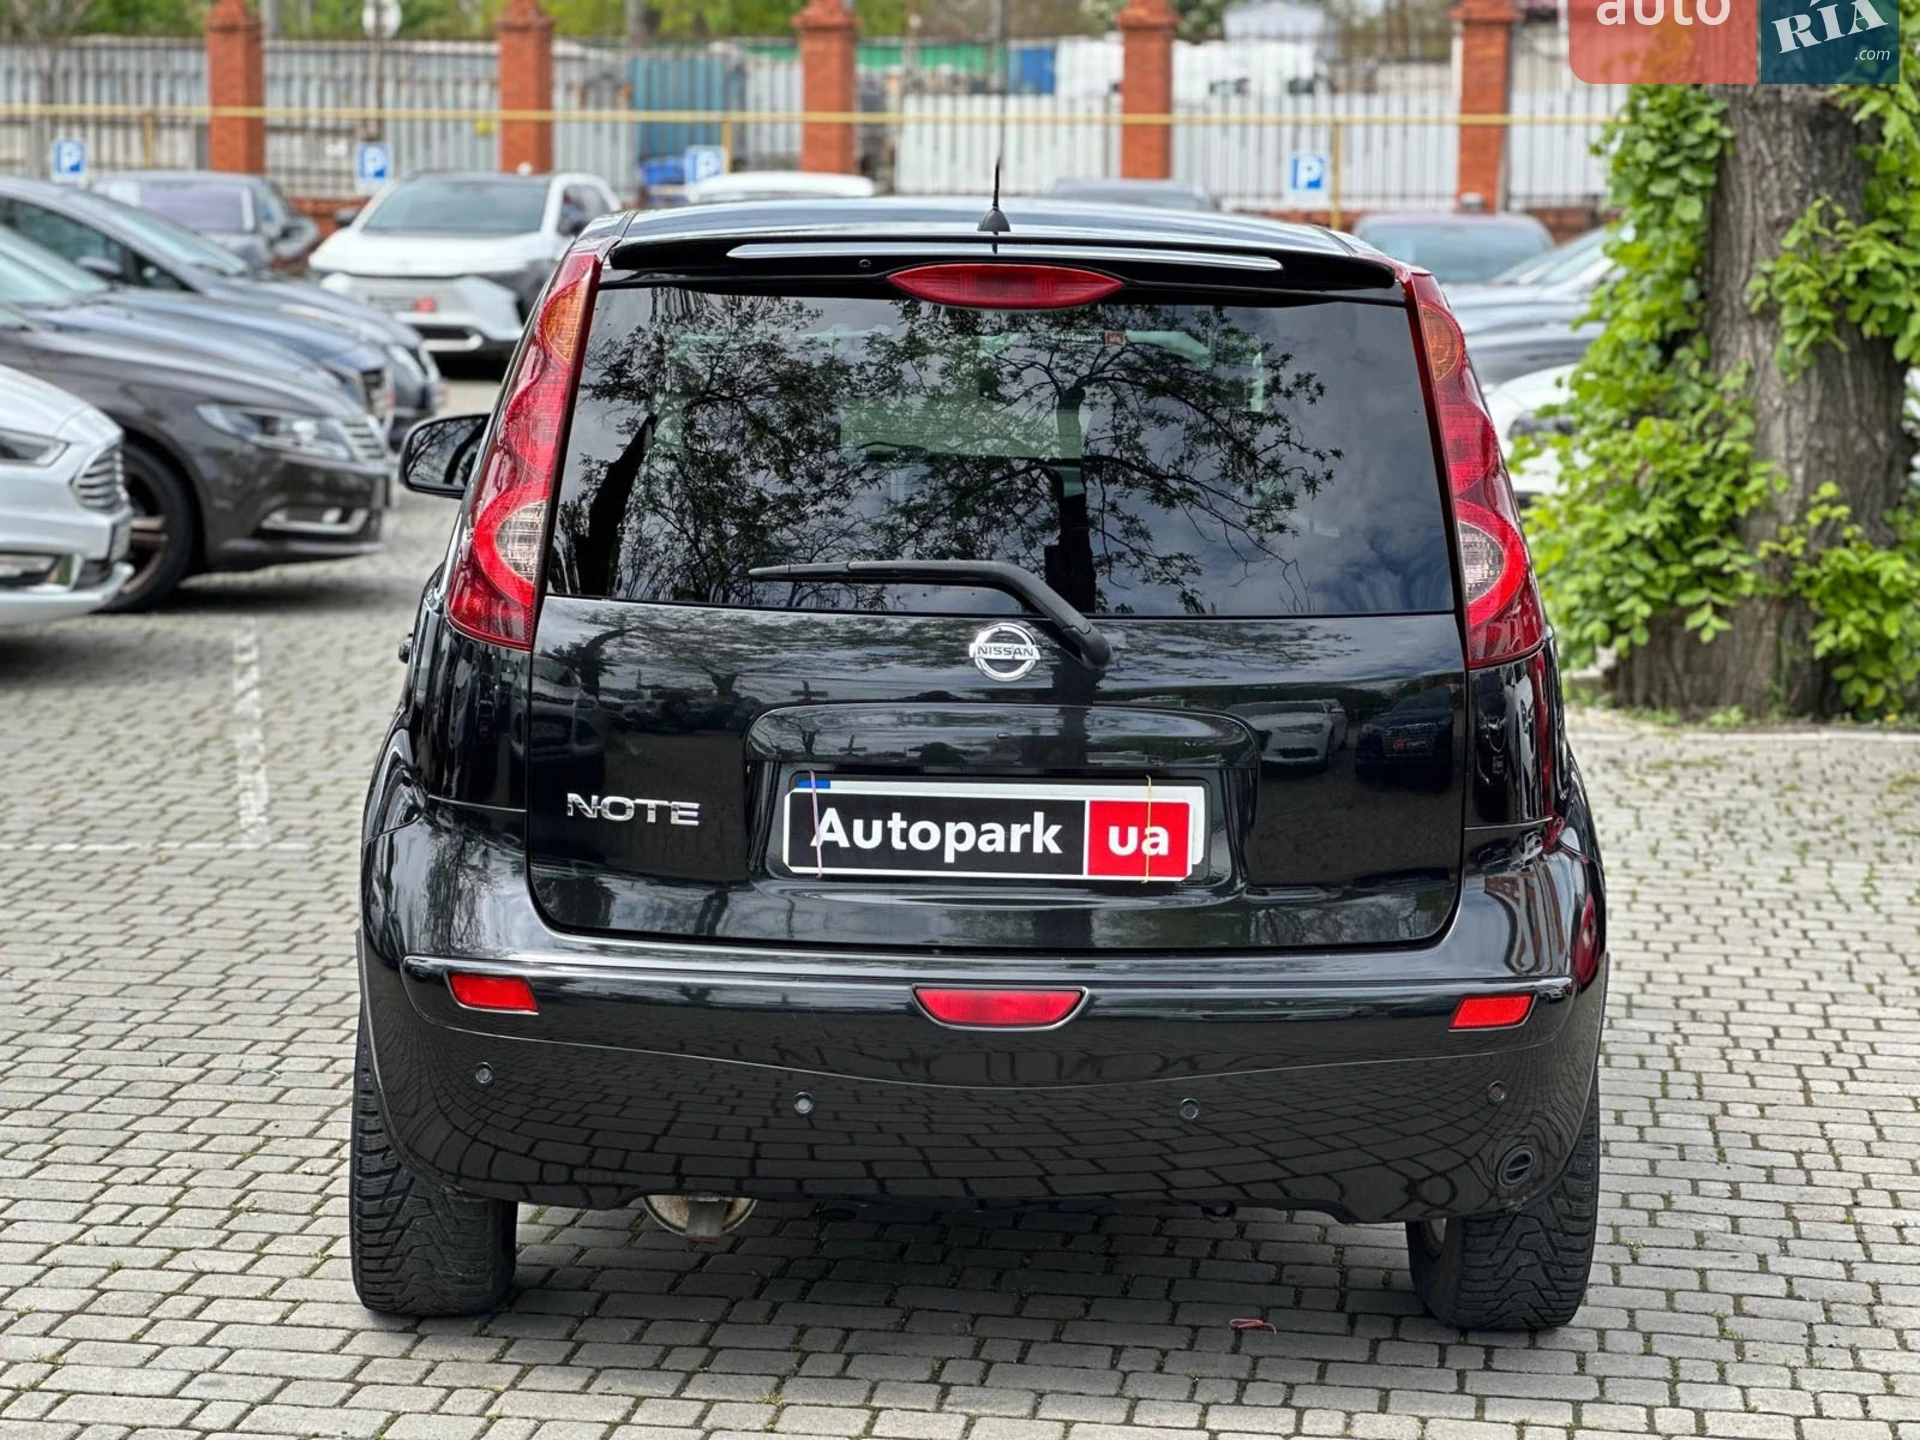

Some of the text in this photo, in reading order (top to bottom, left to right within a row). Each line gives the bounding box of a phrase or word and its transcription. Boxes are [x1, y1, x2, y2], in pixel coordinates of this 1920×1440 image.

[977, 646, 1034, 657] NISSAN
[567, 793, 700, 826] NOTE
[810, 807, 1169, 863] Autopark ua
